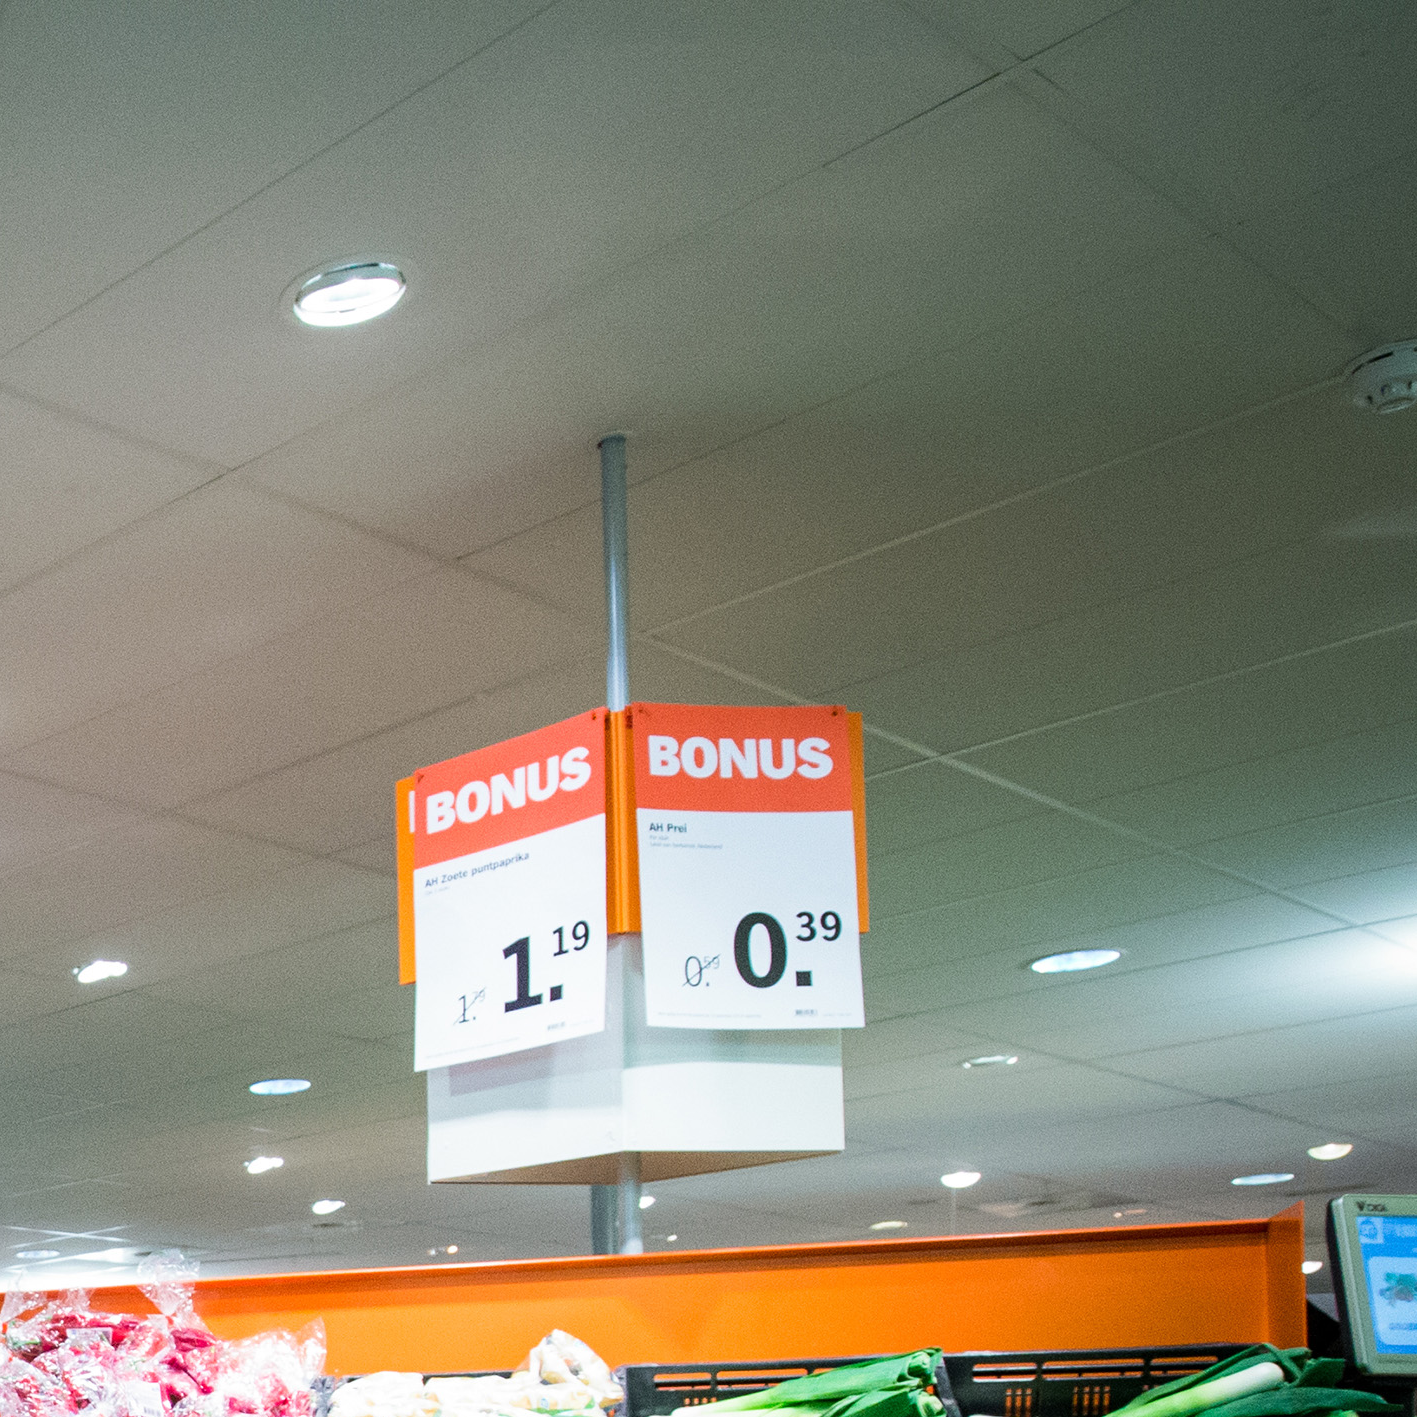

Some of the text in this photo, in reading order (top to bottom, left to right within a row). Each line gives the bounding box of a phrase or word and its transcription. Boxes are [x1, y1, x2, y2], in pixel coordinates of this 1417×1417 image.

[647, 735, 834, 780] BONUS
[426, 746, 592, 834] BONUS
[649, 823, 687, 833] AH Prei
[425, 852, 530, 888] AH Zoete puntpaprika
[502, 920, 591, 1013] 1.19
[733, 911, 843, 989] 0.39
